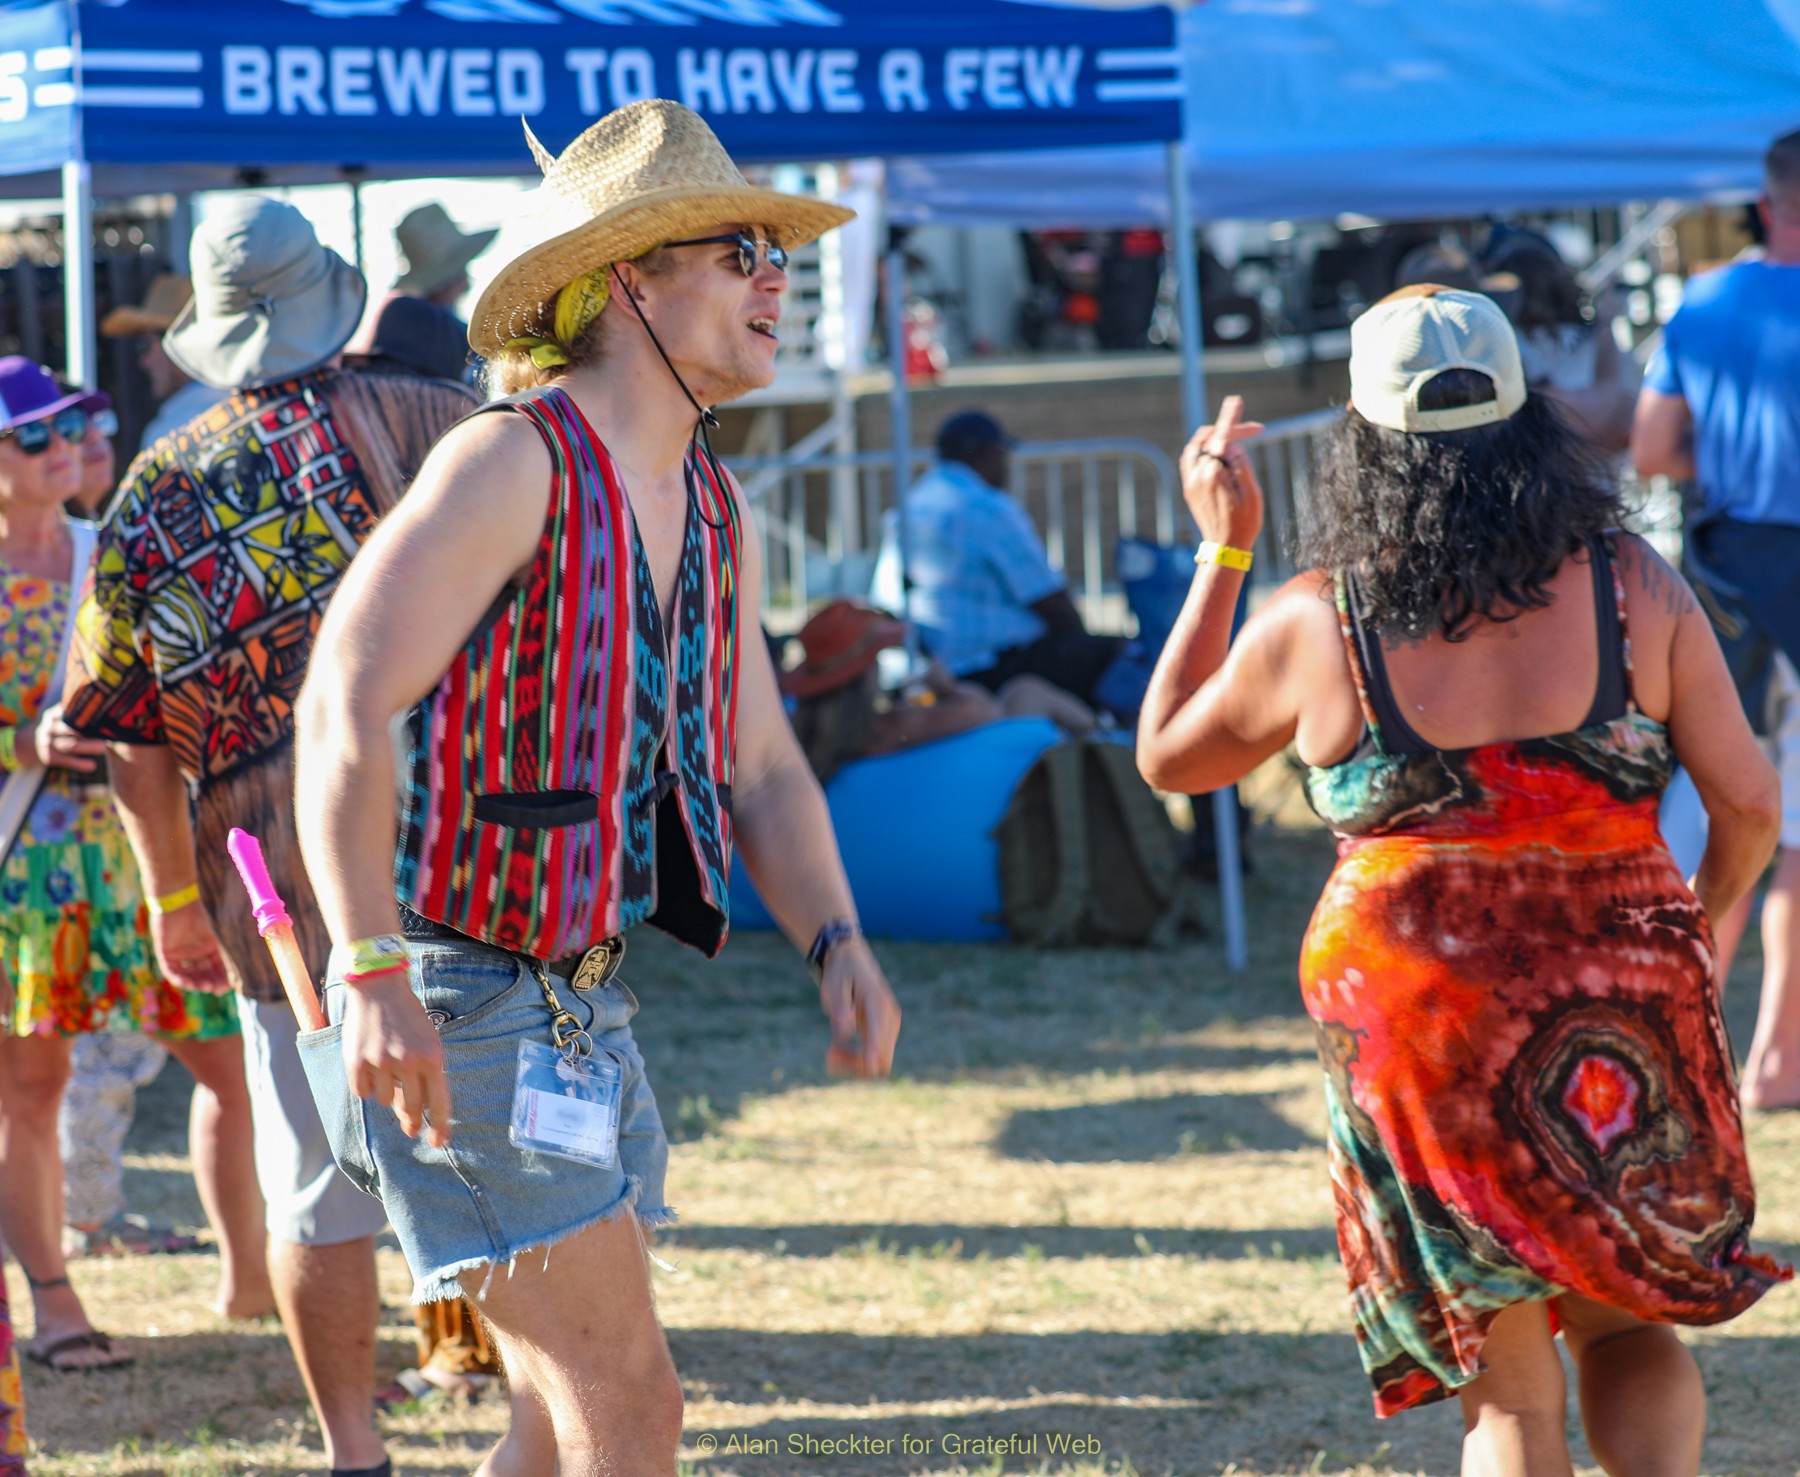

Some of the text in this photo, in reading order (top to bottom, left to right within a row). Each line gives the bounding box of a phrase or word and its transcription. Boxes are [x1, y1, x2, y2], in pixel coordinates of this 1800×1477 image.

[222, 46, 1083, 116] BREWED TO HAVE A FEW
